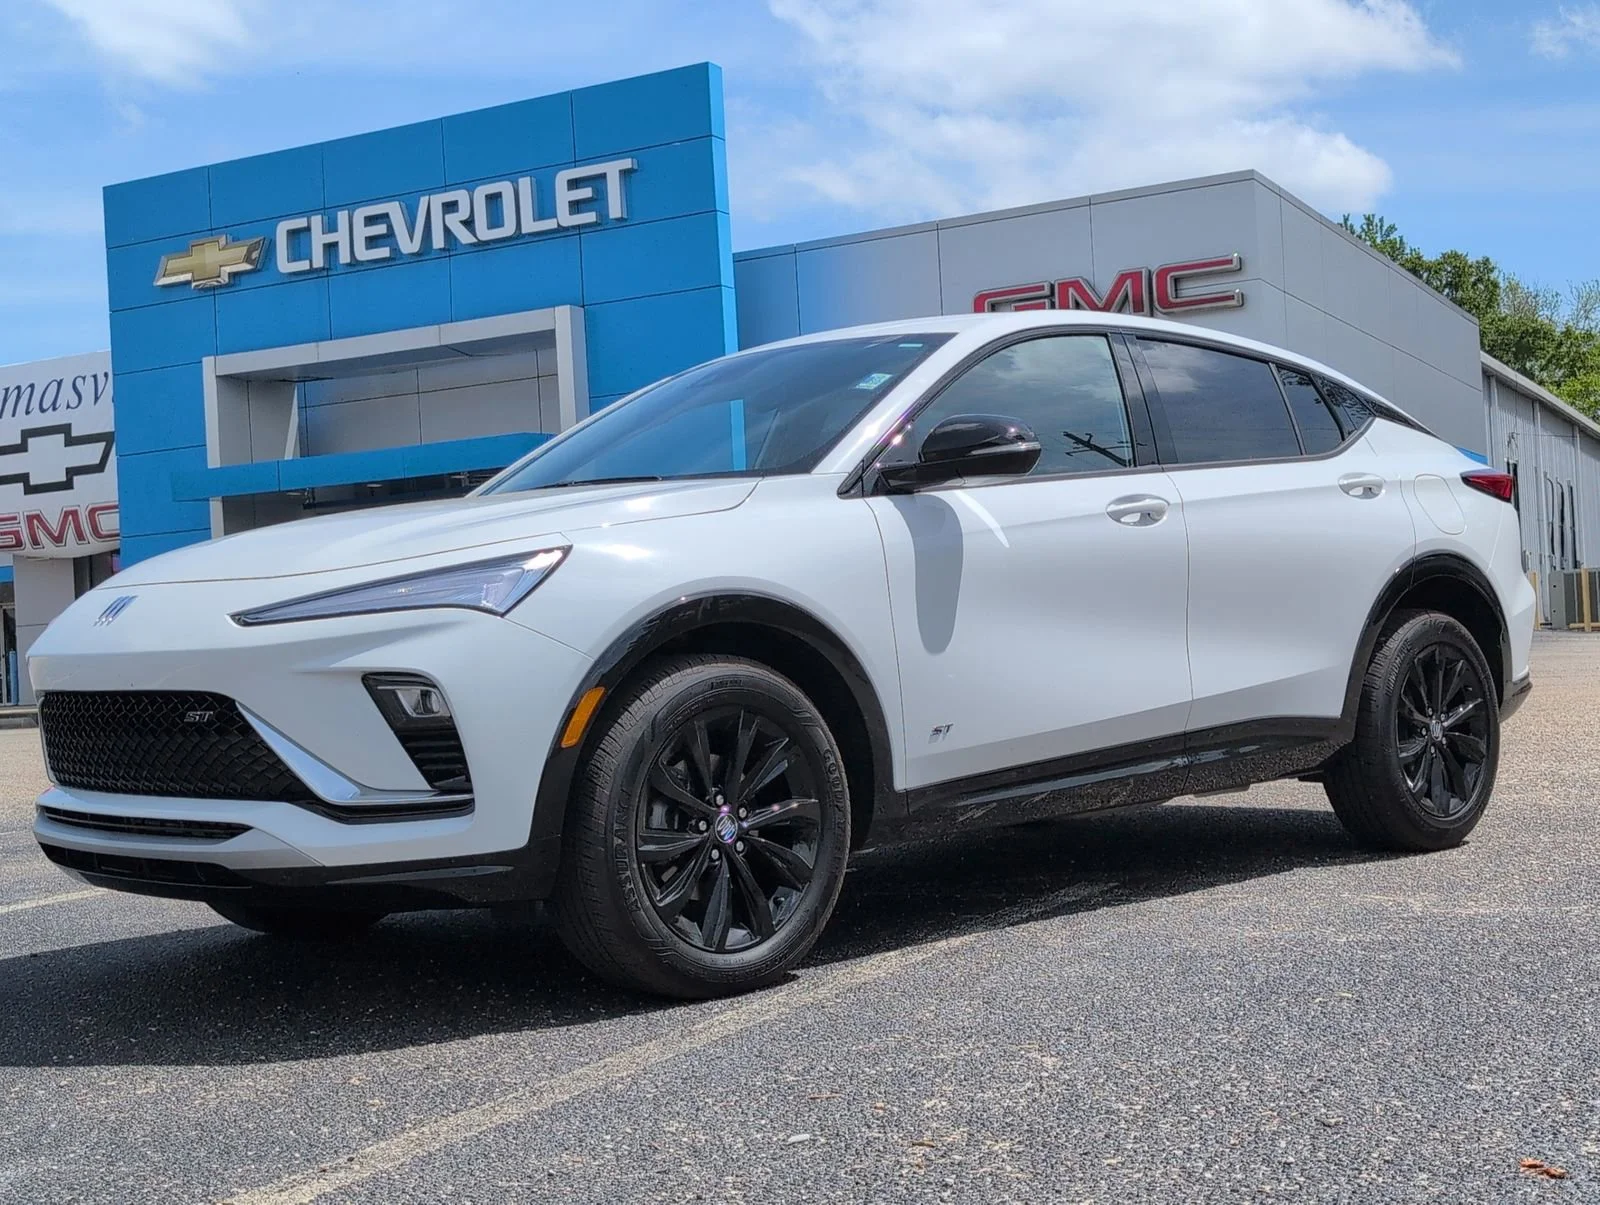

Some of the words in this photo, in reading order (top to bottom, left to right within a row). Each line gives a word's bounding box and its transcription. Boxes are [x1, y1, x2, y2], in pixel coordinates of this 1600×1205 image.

[276, 157, 638, 275] CHEVROLET
[972, 252, 1244, 315] GMC
[184, 710, 214, 723] ST
[929, 723, 954, 738] ST
